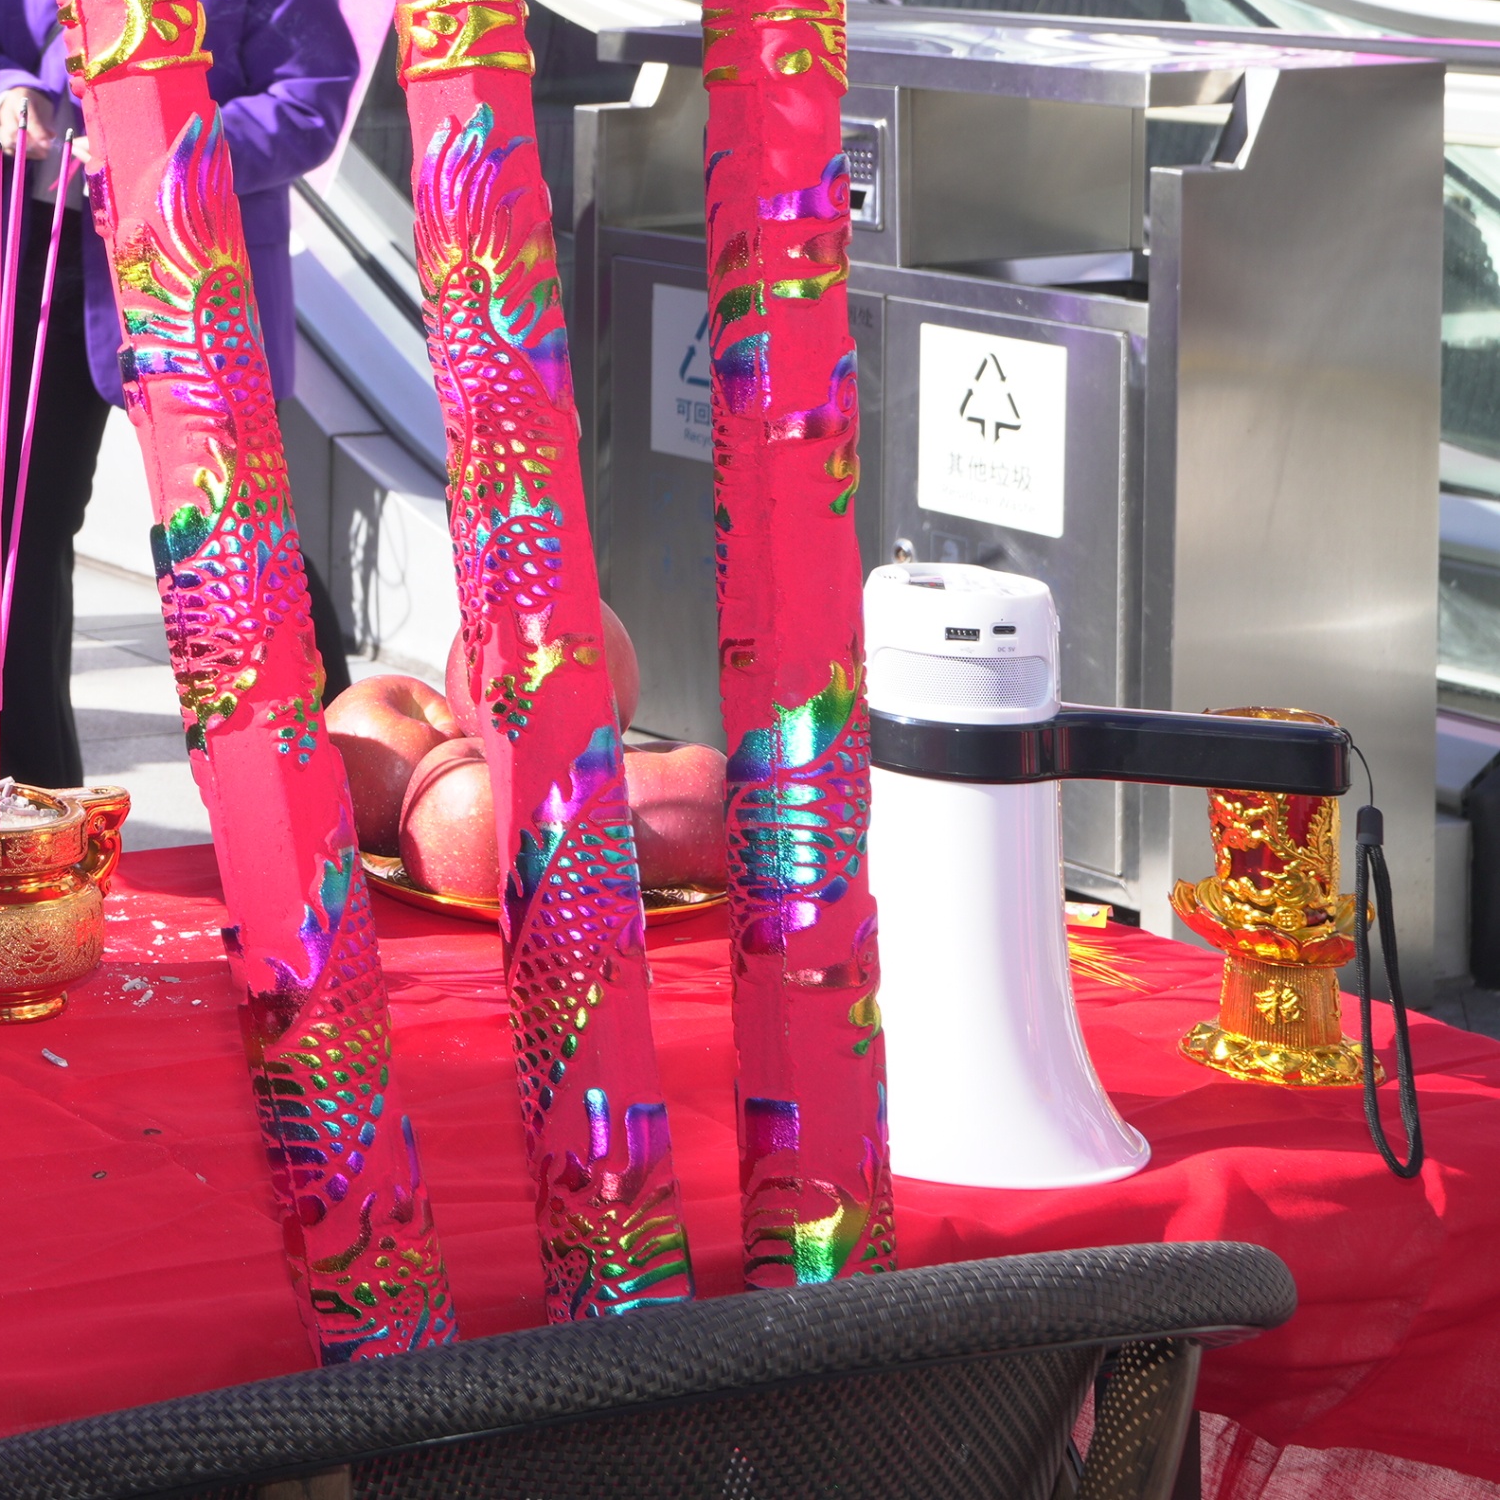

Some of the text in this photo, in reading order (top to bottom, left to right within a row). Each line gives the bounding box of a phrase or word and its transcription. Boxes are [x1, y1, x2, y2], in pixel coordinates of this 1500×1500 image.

[676, 397, 711, 426] 可回
[947, 451, 1034, 494] 其他垃圾
